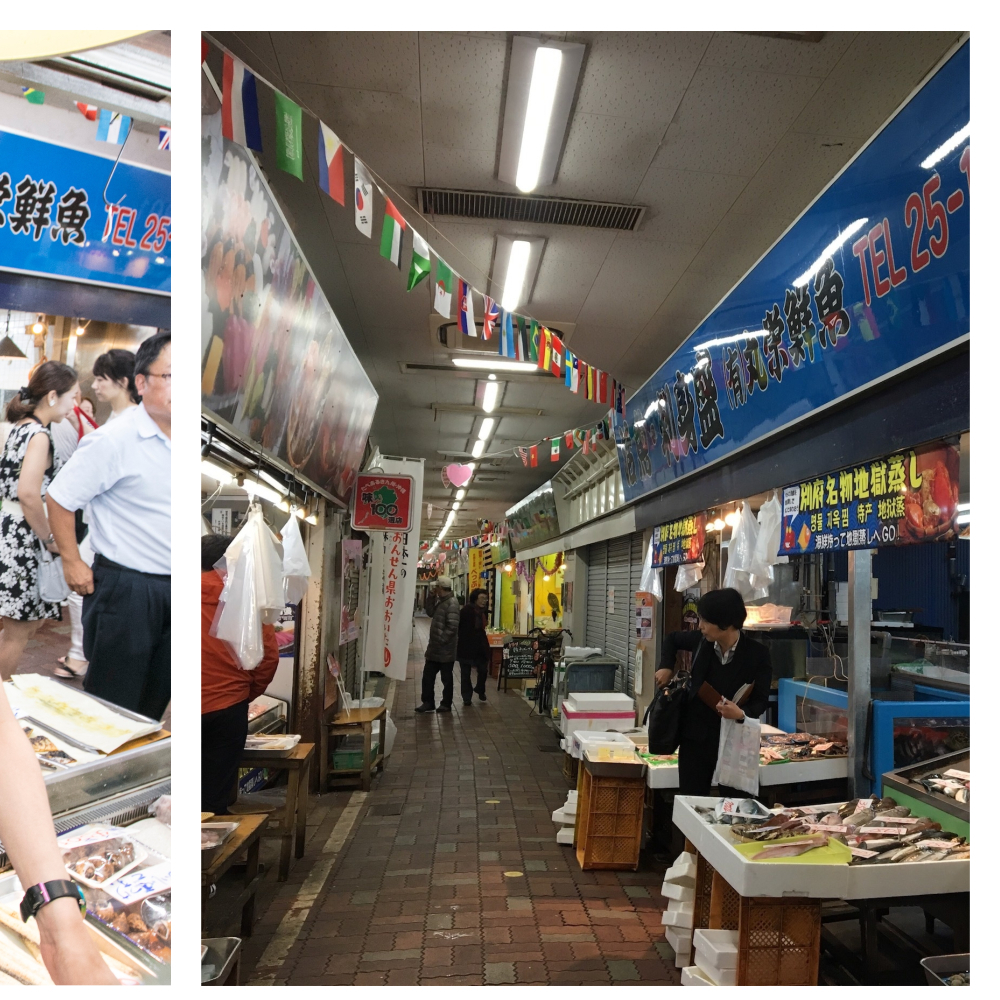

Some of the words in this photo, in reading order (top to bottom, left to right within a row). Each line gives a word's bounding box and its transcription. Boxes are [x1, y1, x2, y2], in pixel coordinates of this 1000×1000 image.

[104, 204, 137, 248] TEL
[853, 217, 907, 306] TEL
[800, 451, 922, 512] 別府名物地獄蒸し
[370, 504, 398, 516] 100
